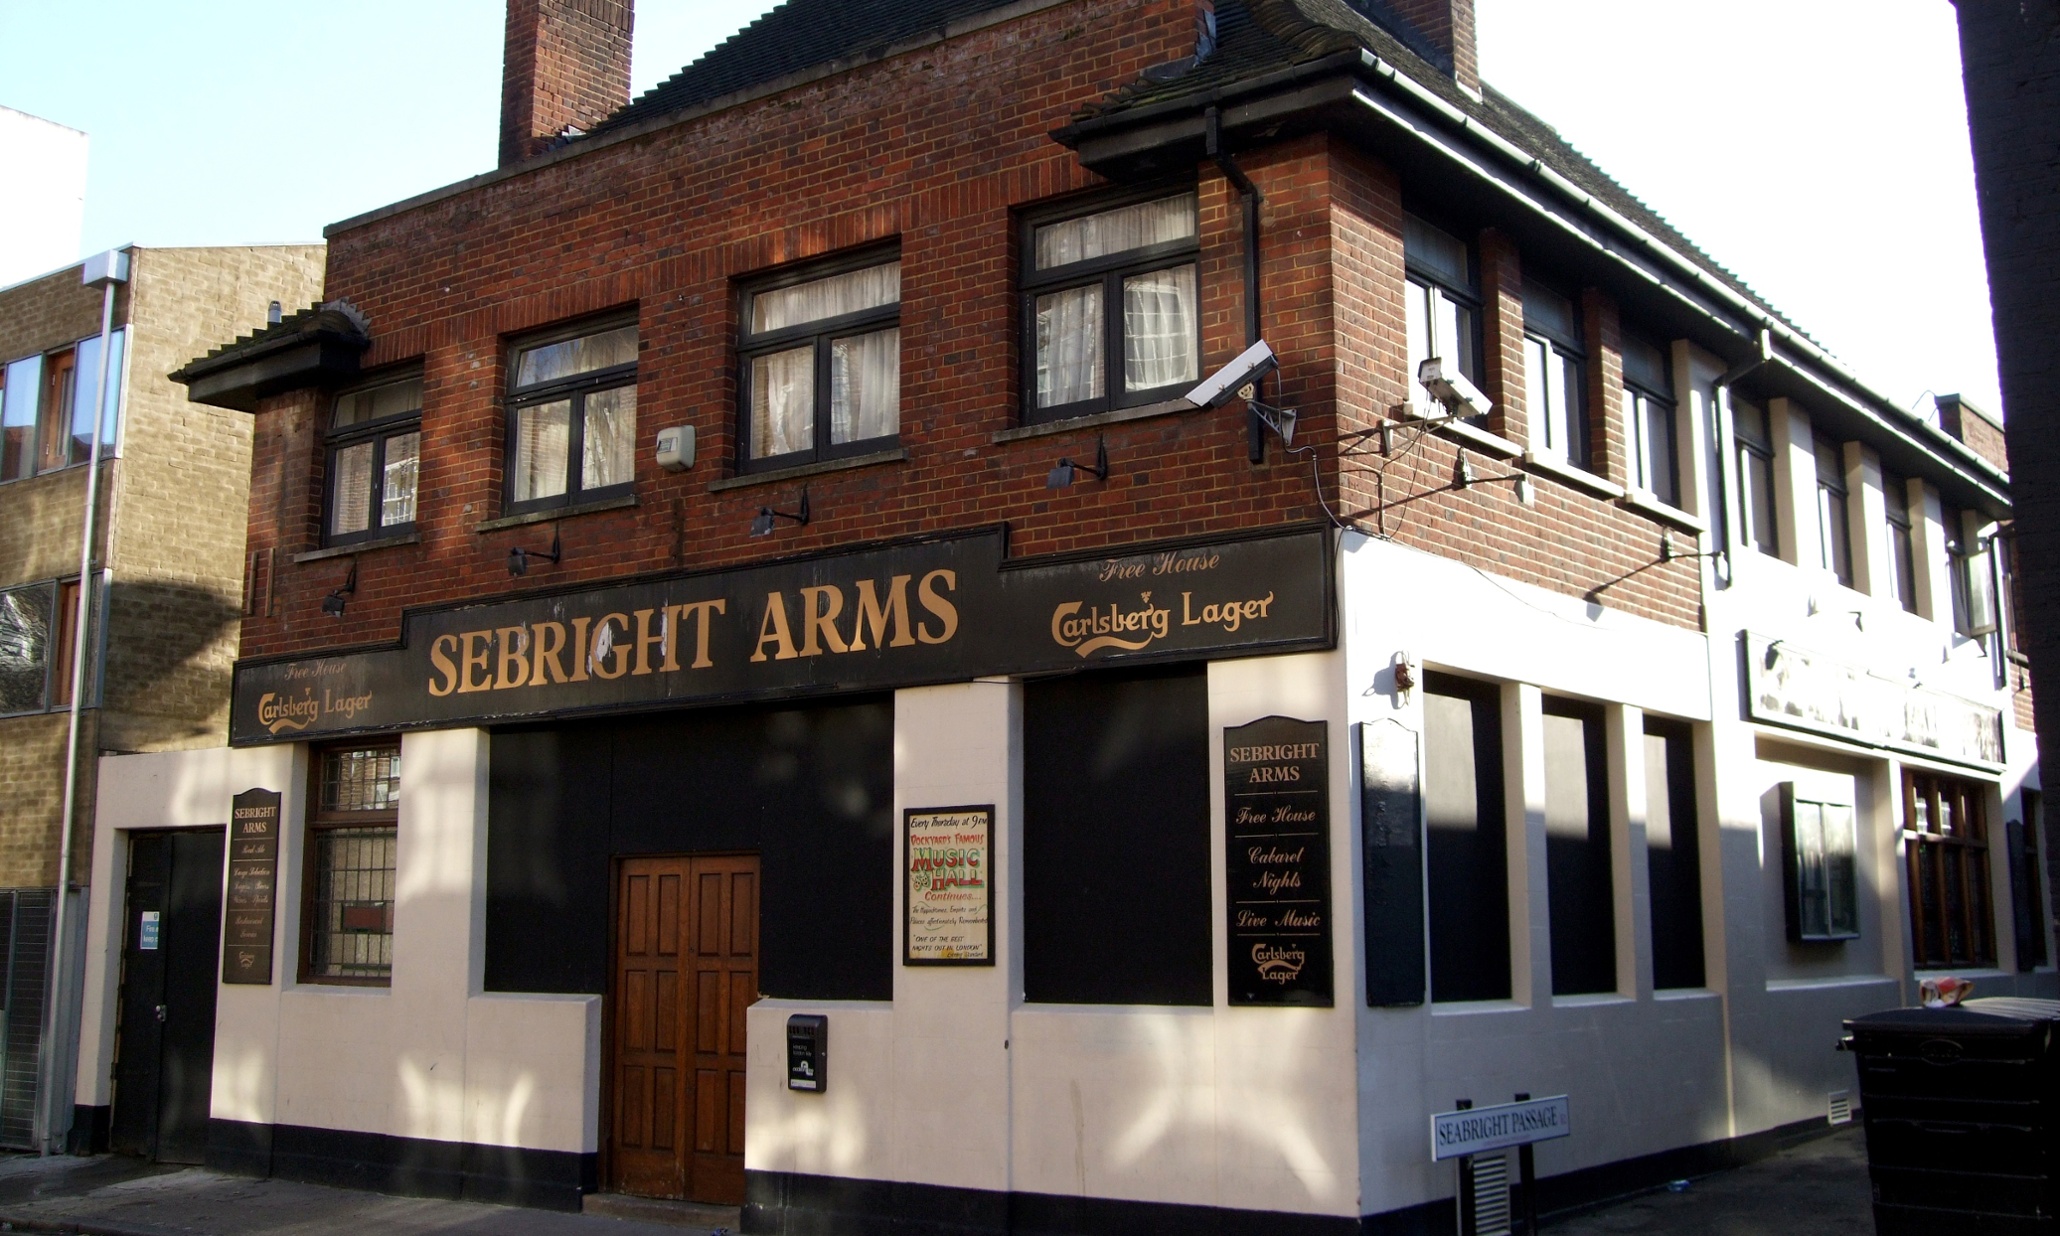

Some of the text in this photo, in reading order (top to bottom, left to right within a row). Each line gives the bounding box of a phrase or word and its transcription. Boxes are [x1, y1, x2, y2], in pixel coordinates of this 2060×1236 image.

[1099, 551, 1220, 582] Free House
[428, 568, 959, 697] SEBRIGHT ARMS
[1051, 590, 1275, 659] Carlsberg Lager
[284, 659, 347, 681] Free House
[258, 688, 373, 734] Carlsberg Lager
[1229, 743, 1320, 763] SEBRIGHT
[1249, 765, 1301, 783] ARMS
[234, 806, 277, 820] SEBRIGHT
[910, 817, 929, 830] Every
[931, 816, 960, 829] Thursday
[961, 817, 970, 826] at
[1235, 804, 1316, 825] Free House
[242, 821, 267, 833] ARMS
[954, 833, 985, 846] FAMOUS
[911, 847, 981, 872] MUSIC
[1248, 846, 1304, 865] Cabaret
[931, 868, 984, 891] HALL
[1252, 873, 1301, 895] Nights
[1236, 909, 1321, 928] Live Music
[1251, 943, 1305, 970] Carlsberg
[1261, 967, 1298, 985] Lager
[1439, 1114, 1510, 1147] SEABRIGHT
[1511, 1105, 1558, 1134] PASSAGE
